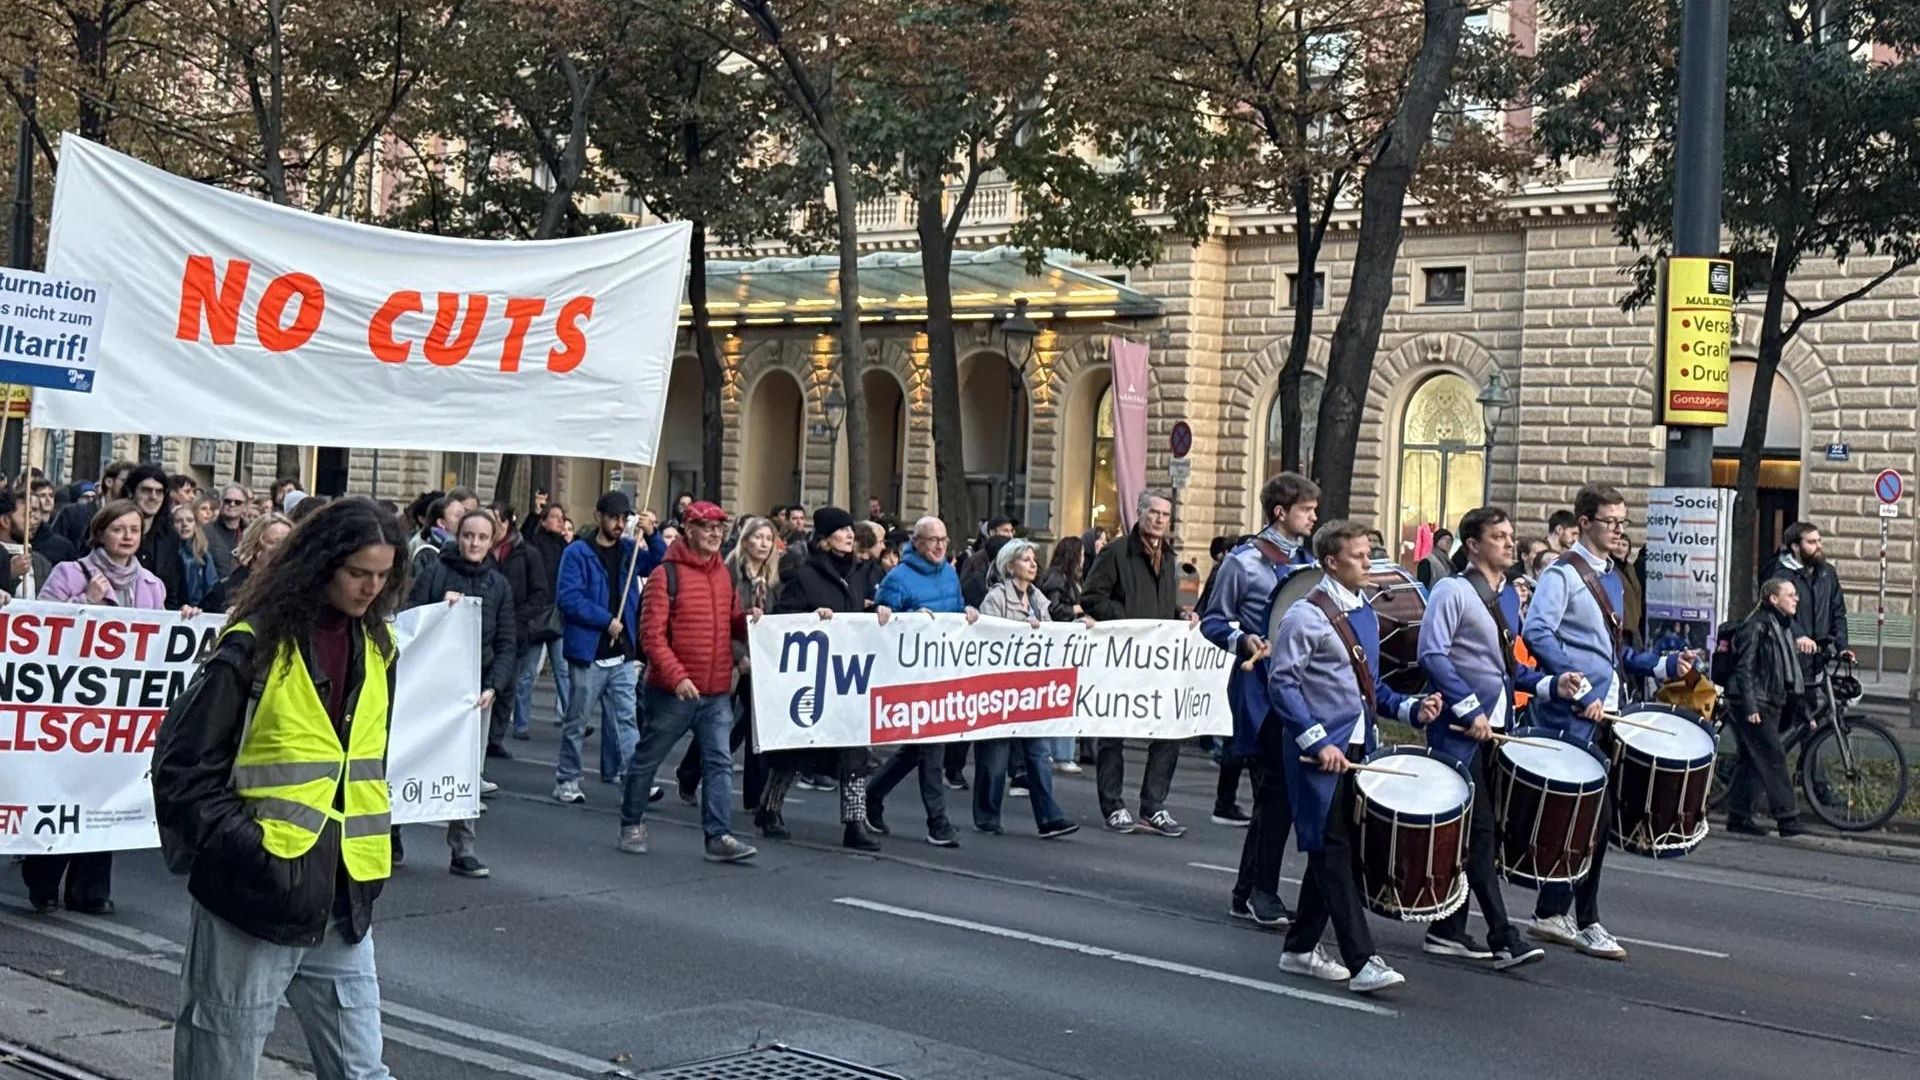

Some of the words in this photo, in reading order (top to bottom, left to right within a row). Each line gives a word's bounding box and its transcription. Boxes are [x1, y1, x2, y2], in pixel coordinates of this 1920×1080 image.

[0, 273, 96, 303] turnation
[1686, 296, 1711, 306] MAIL
[14, 303, 55, 321] nicht
[59, 311, 93, 326] zum
[175, 254, 325, 353] NO
[368, 289, 596, 373] CUTS
[79, 619, 160, 662] IST
[898, 632, 1053, 668] Universität
[1062, 633, 1098, 668] für
[1104, 635, 1193, 672] Musik
[875, 679, 1072, 735] kaputtgesparte
[1075, 684, 1163, 720] Kunst
